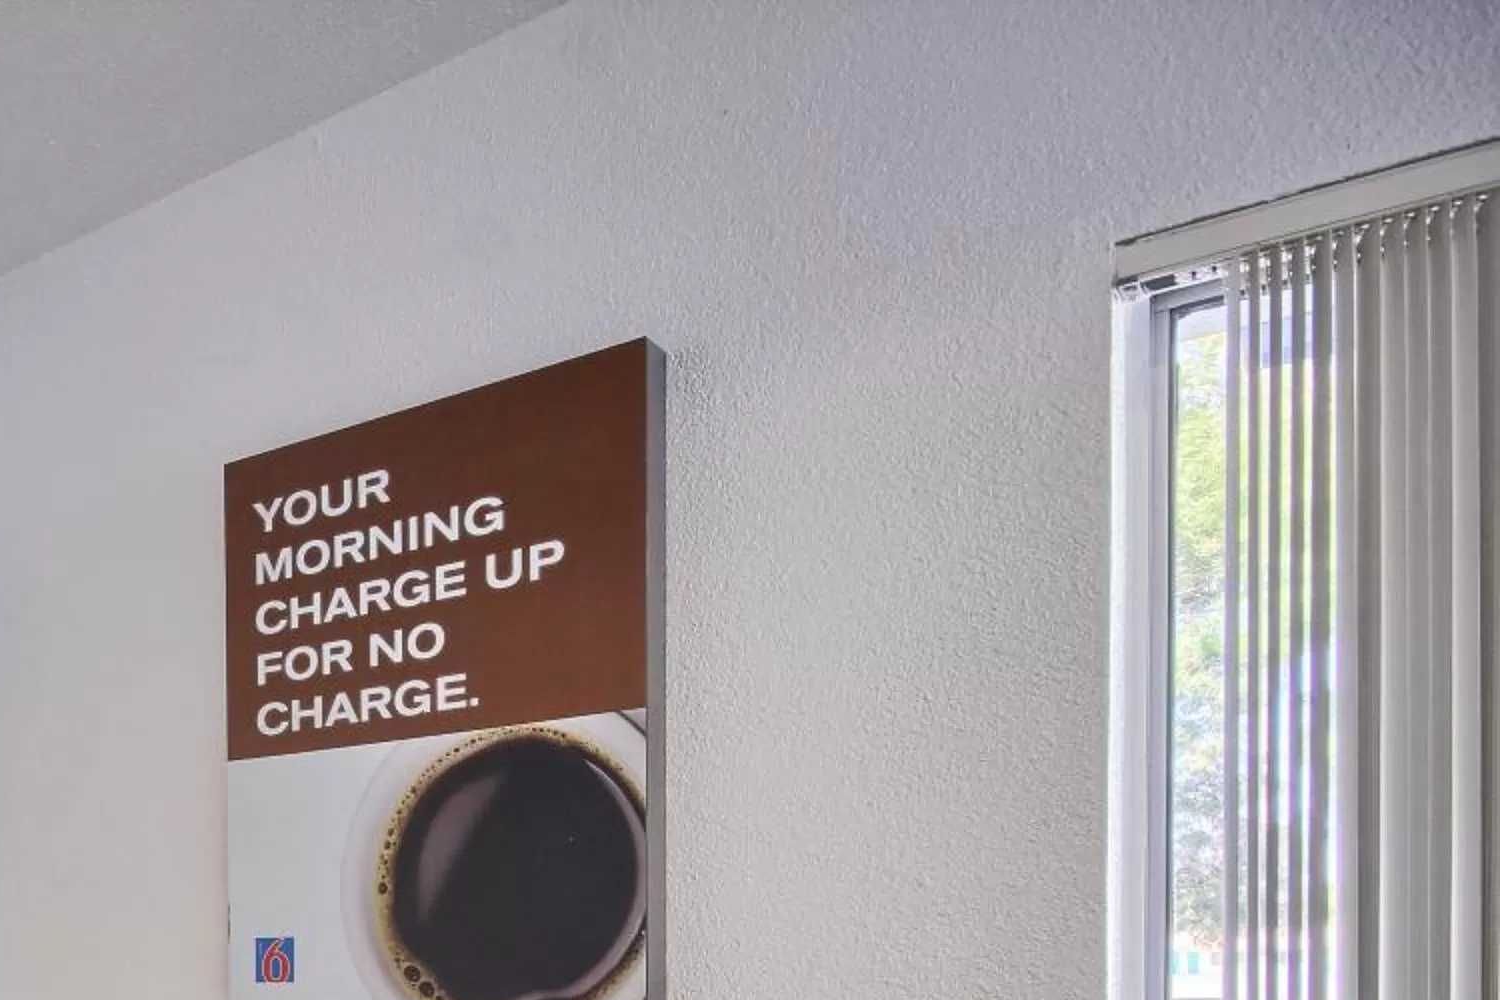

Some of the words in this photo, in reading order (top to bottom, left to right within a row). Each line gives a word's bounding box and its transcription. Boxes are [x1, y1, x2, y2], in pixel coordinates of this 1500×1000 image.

[252, 468, 391, 533] YOUR
[255, 495, 506, 585] MORNING
[255, 560, 467, 636] CHARGE
[485, 539, 565, 589] UP
[256, 639, 354, 686] FOR
[369, 622, 446, 668] NO
[256, 672, 480, 737] CHARGE.
[262, 937, 290, 984] 6
